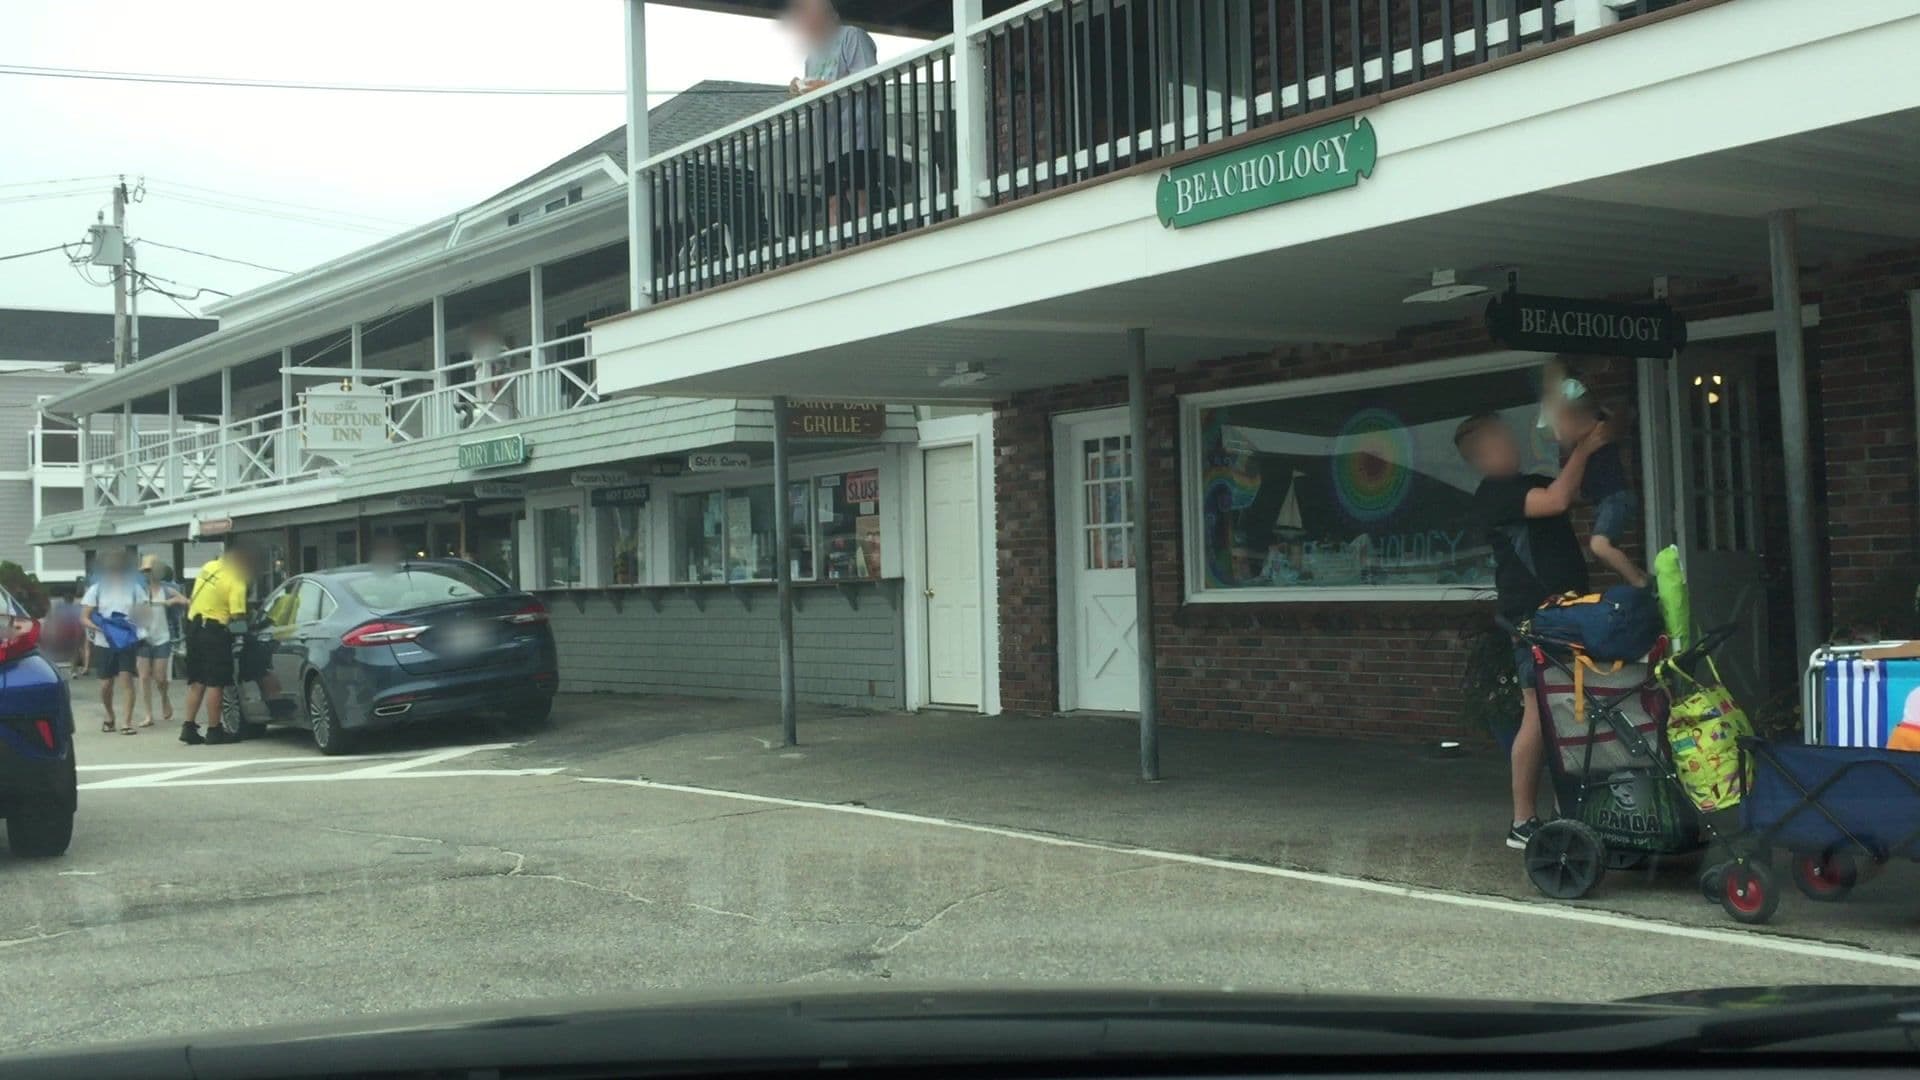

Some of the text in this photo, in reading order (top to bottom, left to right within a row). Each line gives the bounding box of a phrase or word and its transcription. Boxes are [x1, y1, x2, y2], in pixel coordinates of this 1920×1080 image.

[1174, 132, 1352, 215] BEACHOLOGY
[1520, 307, 1663, 342] BEACHOLOGY
[312, 411, 383, 426] NEPTUNE
[803, 415, 862, 434] GRILLE
[332, 427, 362, 442] INN
[460, 438, 519, 468] DAIRY KING
[695, 456, 716, 467] Soft
[1598, 808, 1661, 833] PANDA
